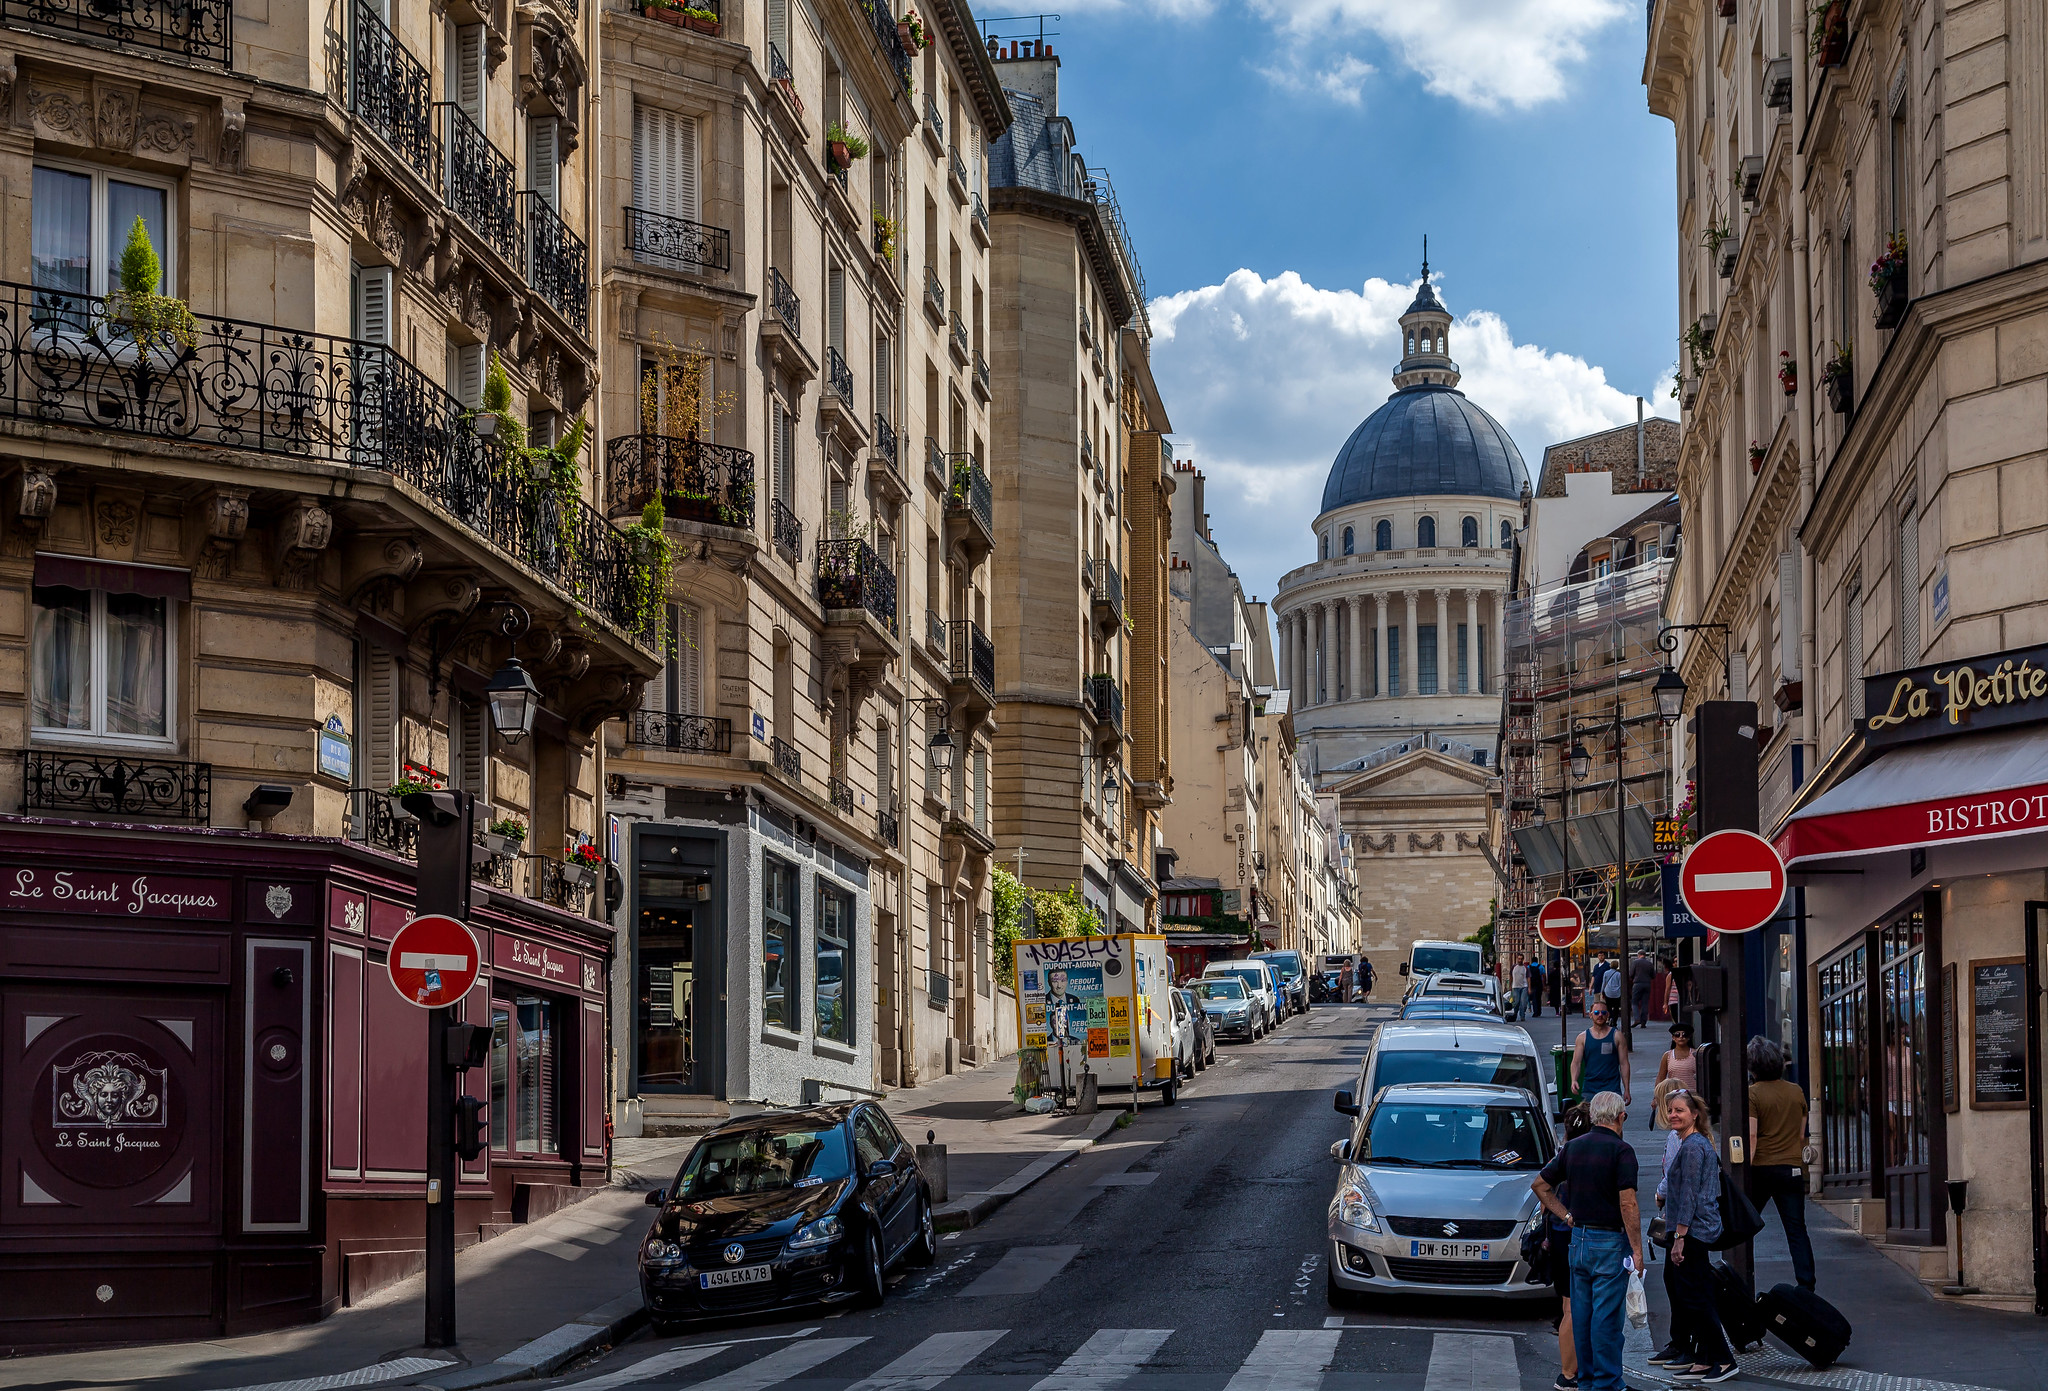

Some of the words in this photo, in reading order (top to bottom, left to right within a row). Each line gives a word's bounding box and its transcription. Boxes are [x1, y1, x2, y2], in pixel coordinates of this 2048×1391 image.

[1868, 676, 1931, 731] La
[1933, 658, 2048, 726] Petite
[1927, 794, 2048, 835] BISTROT
[1655, 821, 1679, 832] ZIG
[1238, 833, 1246, 884] BISTROT
[9, 868, 44, 898] Le
[52, 871, 120, 902] Saint
[127, 875, 218, 914] Jacques
[511, 938, 523, 964] Le
[523, 941, 542, 969] Saint
[541, 946, 566, 978] Jacques
[1044, 960, 1102, 970] DUPONT-AIGNAN
[1069, 977, 1096, 985] DEBOUT
[1089, 1007, 1106, 1020] Bach
[1110, 1005, 1127, 1018] Bach
[1089, 1039, 1107, 1054] Chopin
[55, 1131, 73, 1148] Le
[76, 1131, 111, 1148] Saint
[113, 1132, 161, 1153] Jacques
[710, 1271, 730, 1286] 494
[731, 1268, 752, 1283] EKA
[754, 1267, 767, 1281] 78
